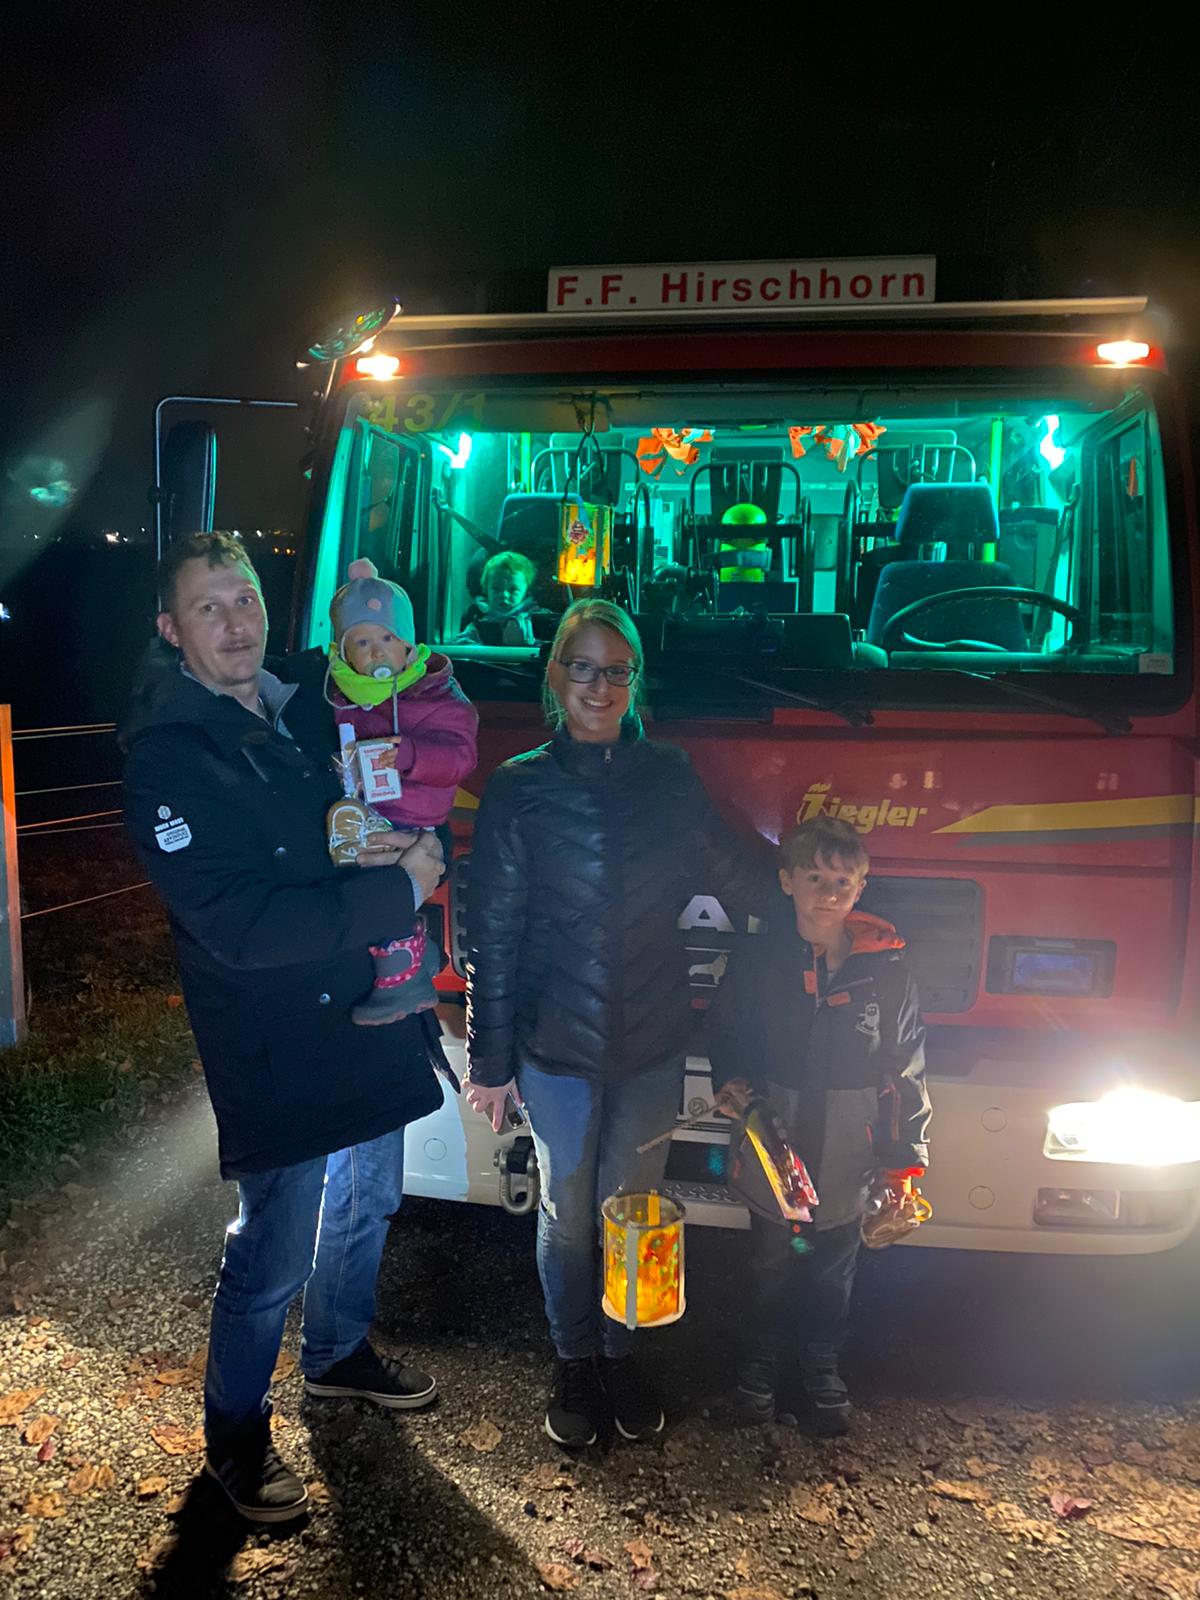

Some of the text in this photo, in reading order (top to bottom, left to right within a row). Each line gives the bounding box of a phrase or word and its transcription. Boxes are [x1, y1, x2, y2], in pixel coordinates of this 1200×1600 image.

[556, 268, 925, 305] F.F. Hirschhorn
[369, 392, 486, 432] 43/1
[797, 783, 928, 834] Ziegler
